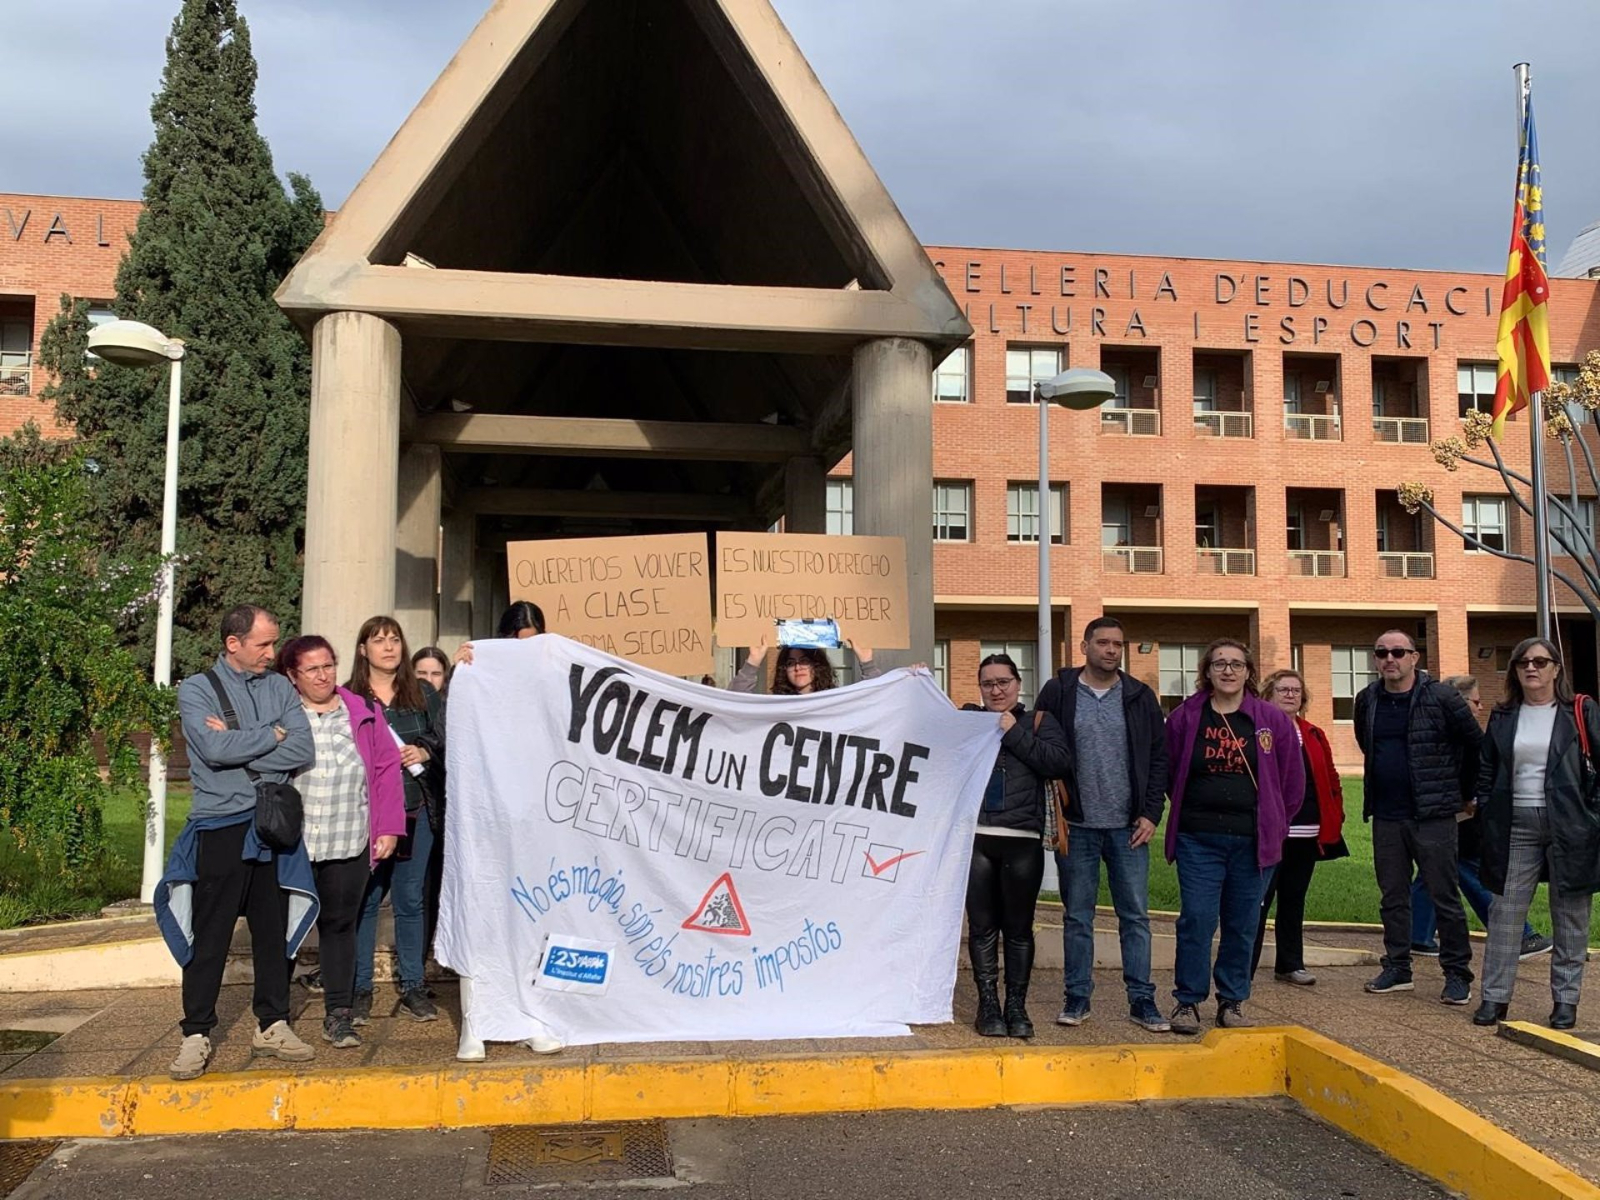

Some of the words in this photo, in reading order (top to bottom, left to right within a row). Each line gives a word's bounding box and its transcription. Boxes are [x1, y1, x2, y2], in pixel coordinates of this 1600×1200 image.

[935, 261, 1178, 302] ELLERIA
[1194, 311, 1200, 340] I
[1244, 313, 1445, 350] ESPORT
[516, 555, 622, 587] QUEREMOS
[634, 551, 703, 579] VOLVER
[723, 547, 748, 573] ES
[753, 549, 824, 574] NUESTRO
[829, 552, 890, 576] DERECHO
[557, 593, 570, 623] A
[584, 588, 670, 619] CLASE
[724, 593, 747, 619] ES
[754, 593, 826, 619] VUESTRO
[833, 596, 891, 621] DEBER
[624, 628, 704, 656] SEGURA
[567, 663, 713, 780] VOLEM
[705, 748, 747, 791] UN
[759, 722, 930, 818] CENTRE
[1205, 726, 1229, 740] NO
[1205, 746, 1225, 759] DA
[545, 759, 869, 884] CERTIFICAT
[511, 876, 550, 923] No
[548, 856, 570, 902] és
[618, 903, 663, 945] són
[634, 932, 679, 976] els
[663, 947, 743, 998] nostres
[752, 918, 841, 993] impostos
